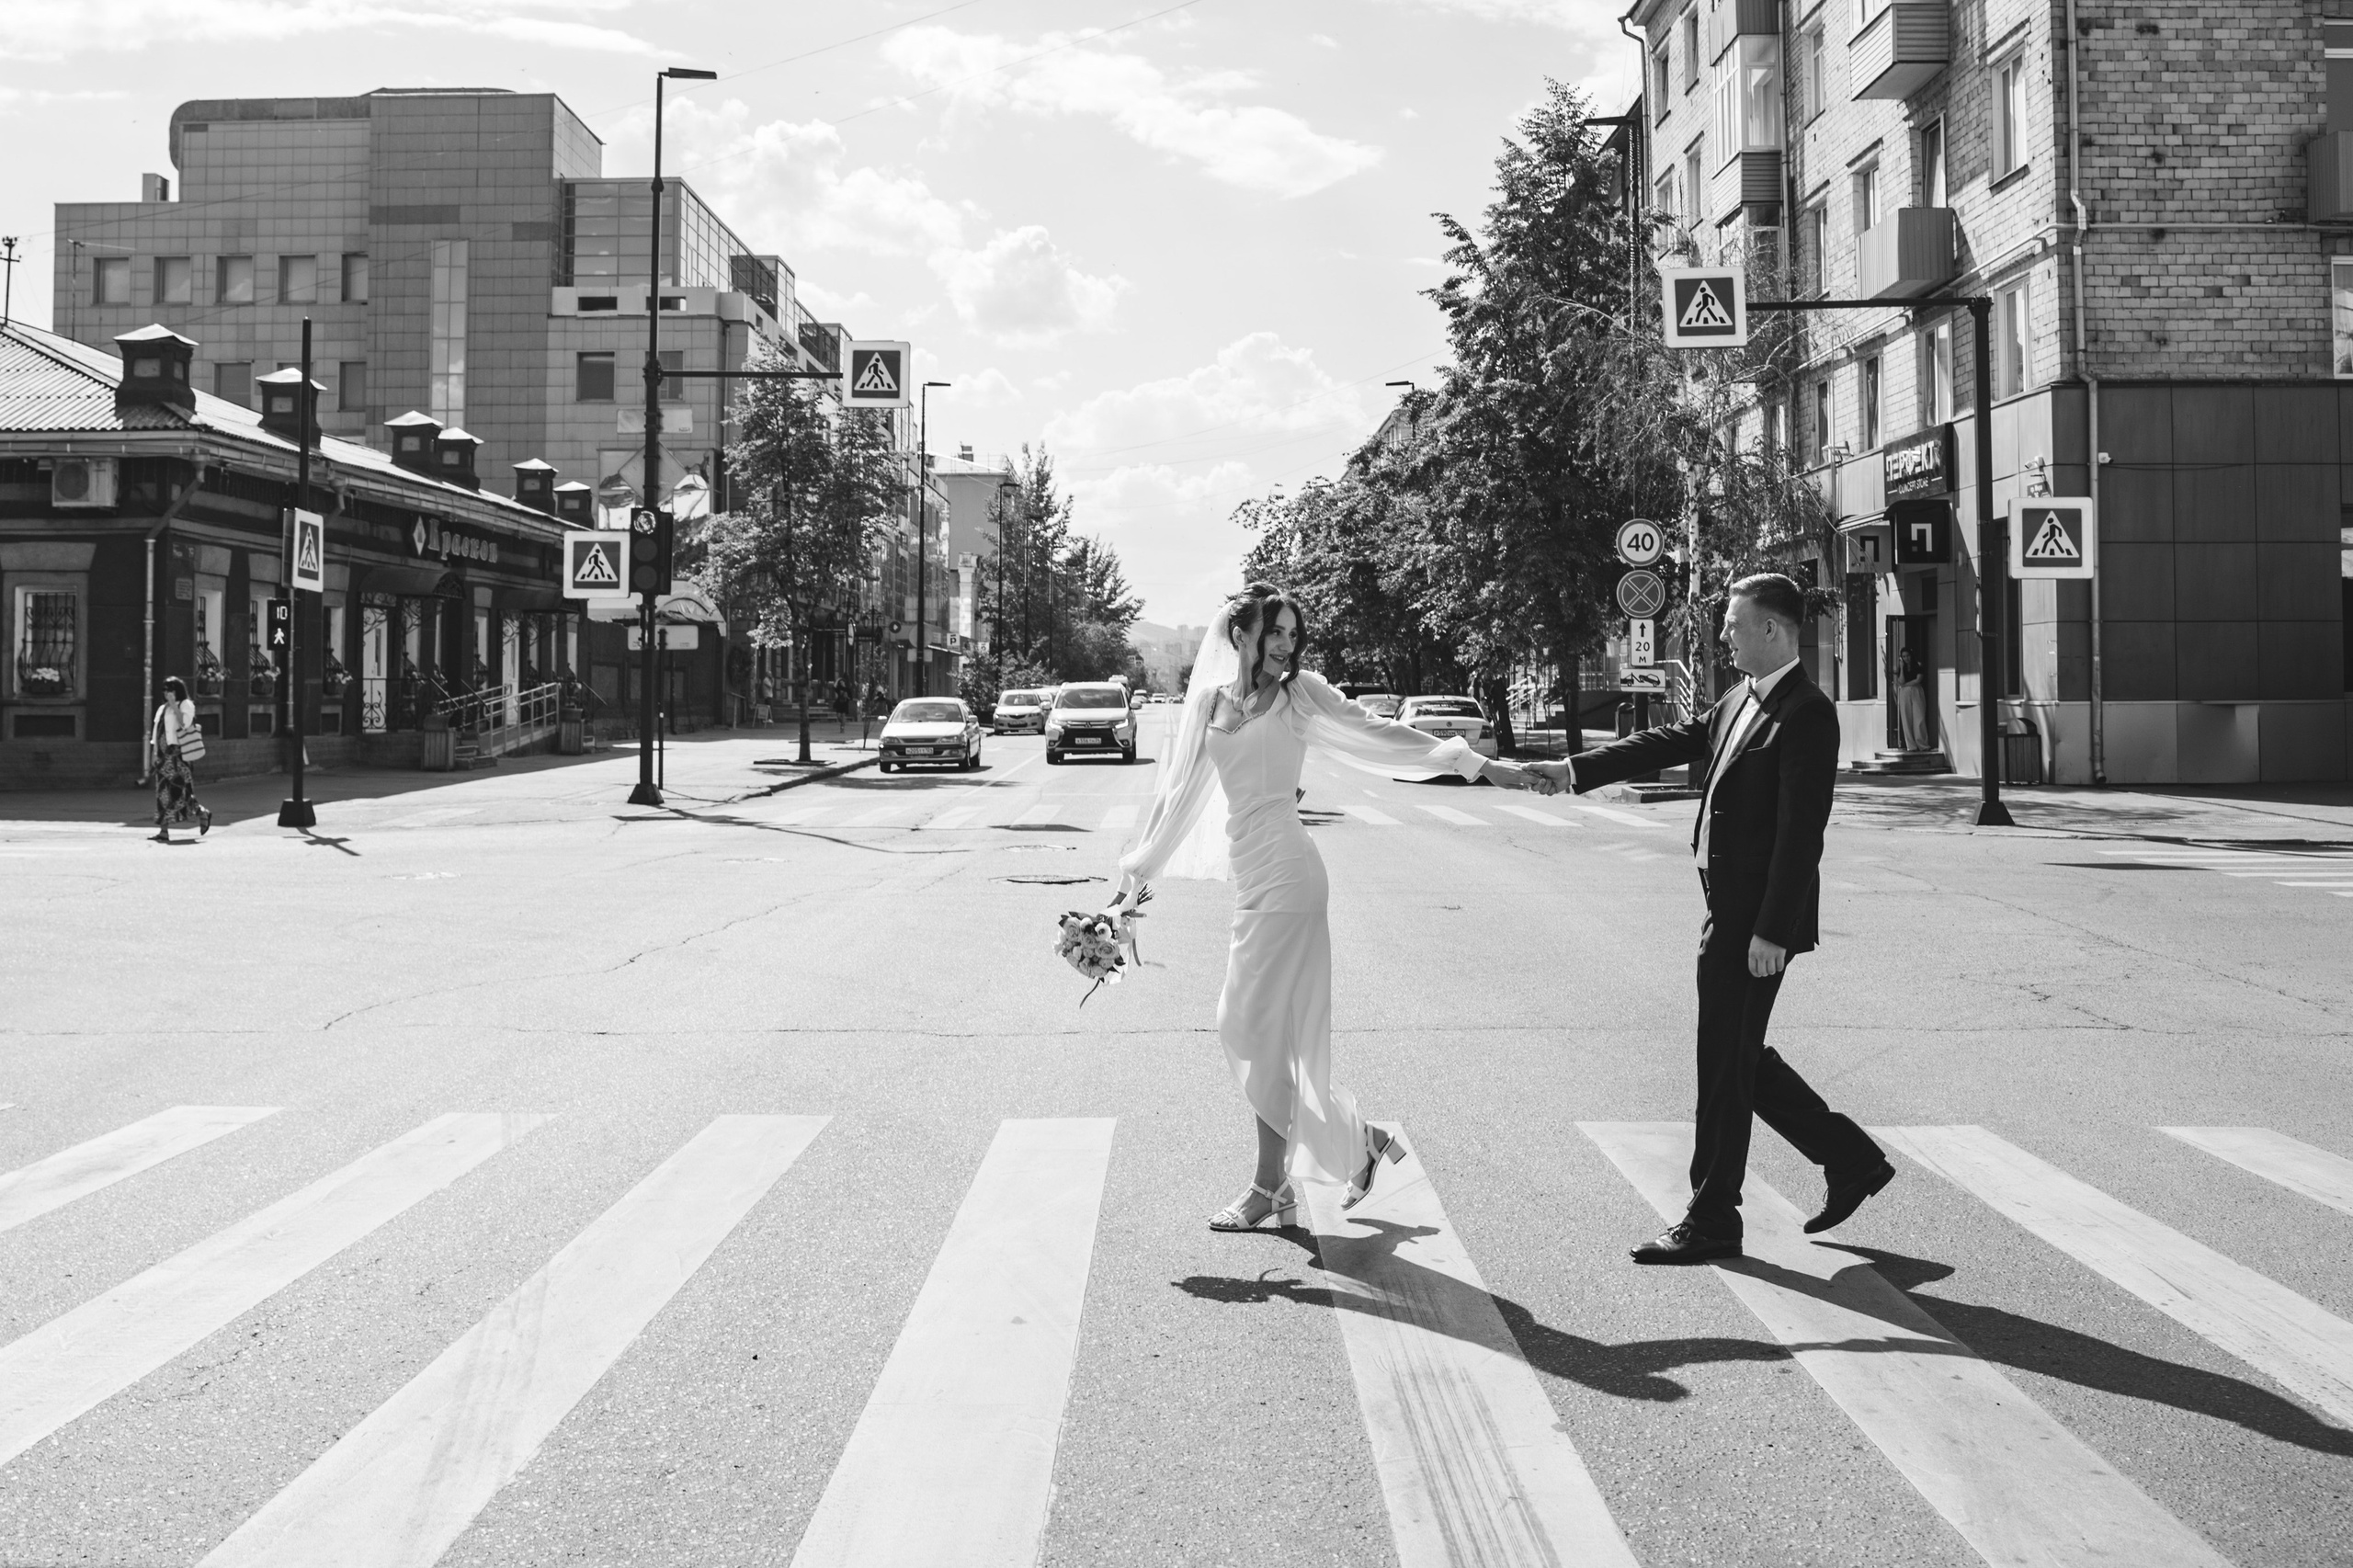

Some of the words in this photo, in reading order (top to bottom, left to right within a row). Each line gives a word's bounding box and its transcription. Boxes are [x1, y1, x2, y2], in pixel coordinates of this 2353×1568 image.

[1627, 532, 1654, 551] 40
[277, 606, 288, 619] 10
[1635, 642, 1651, 652] 20
